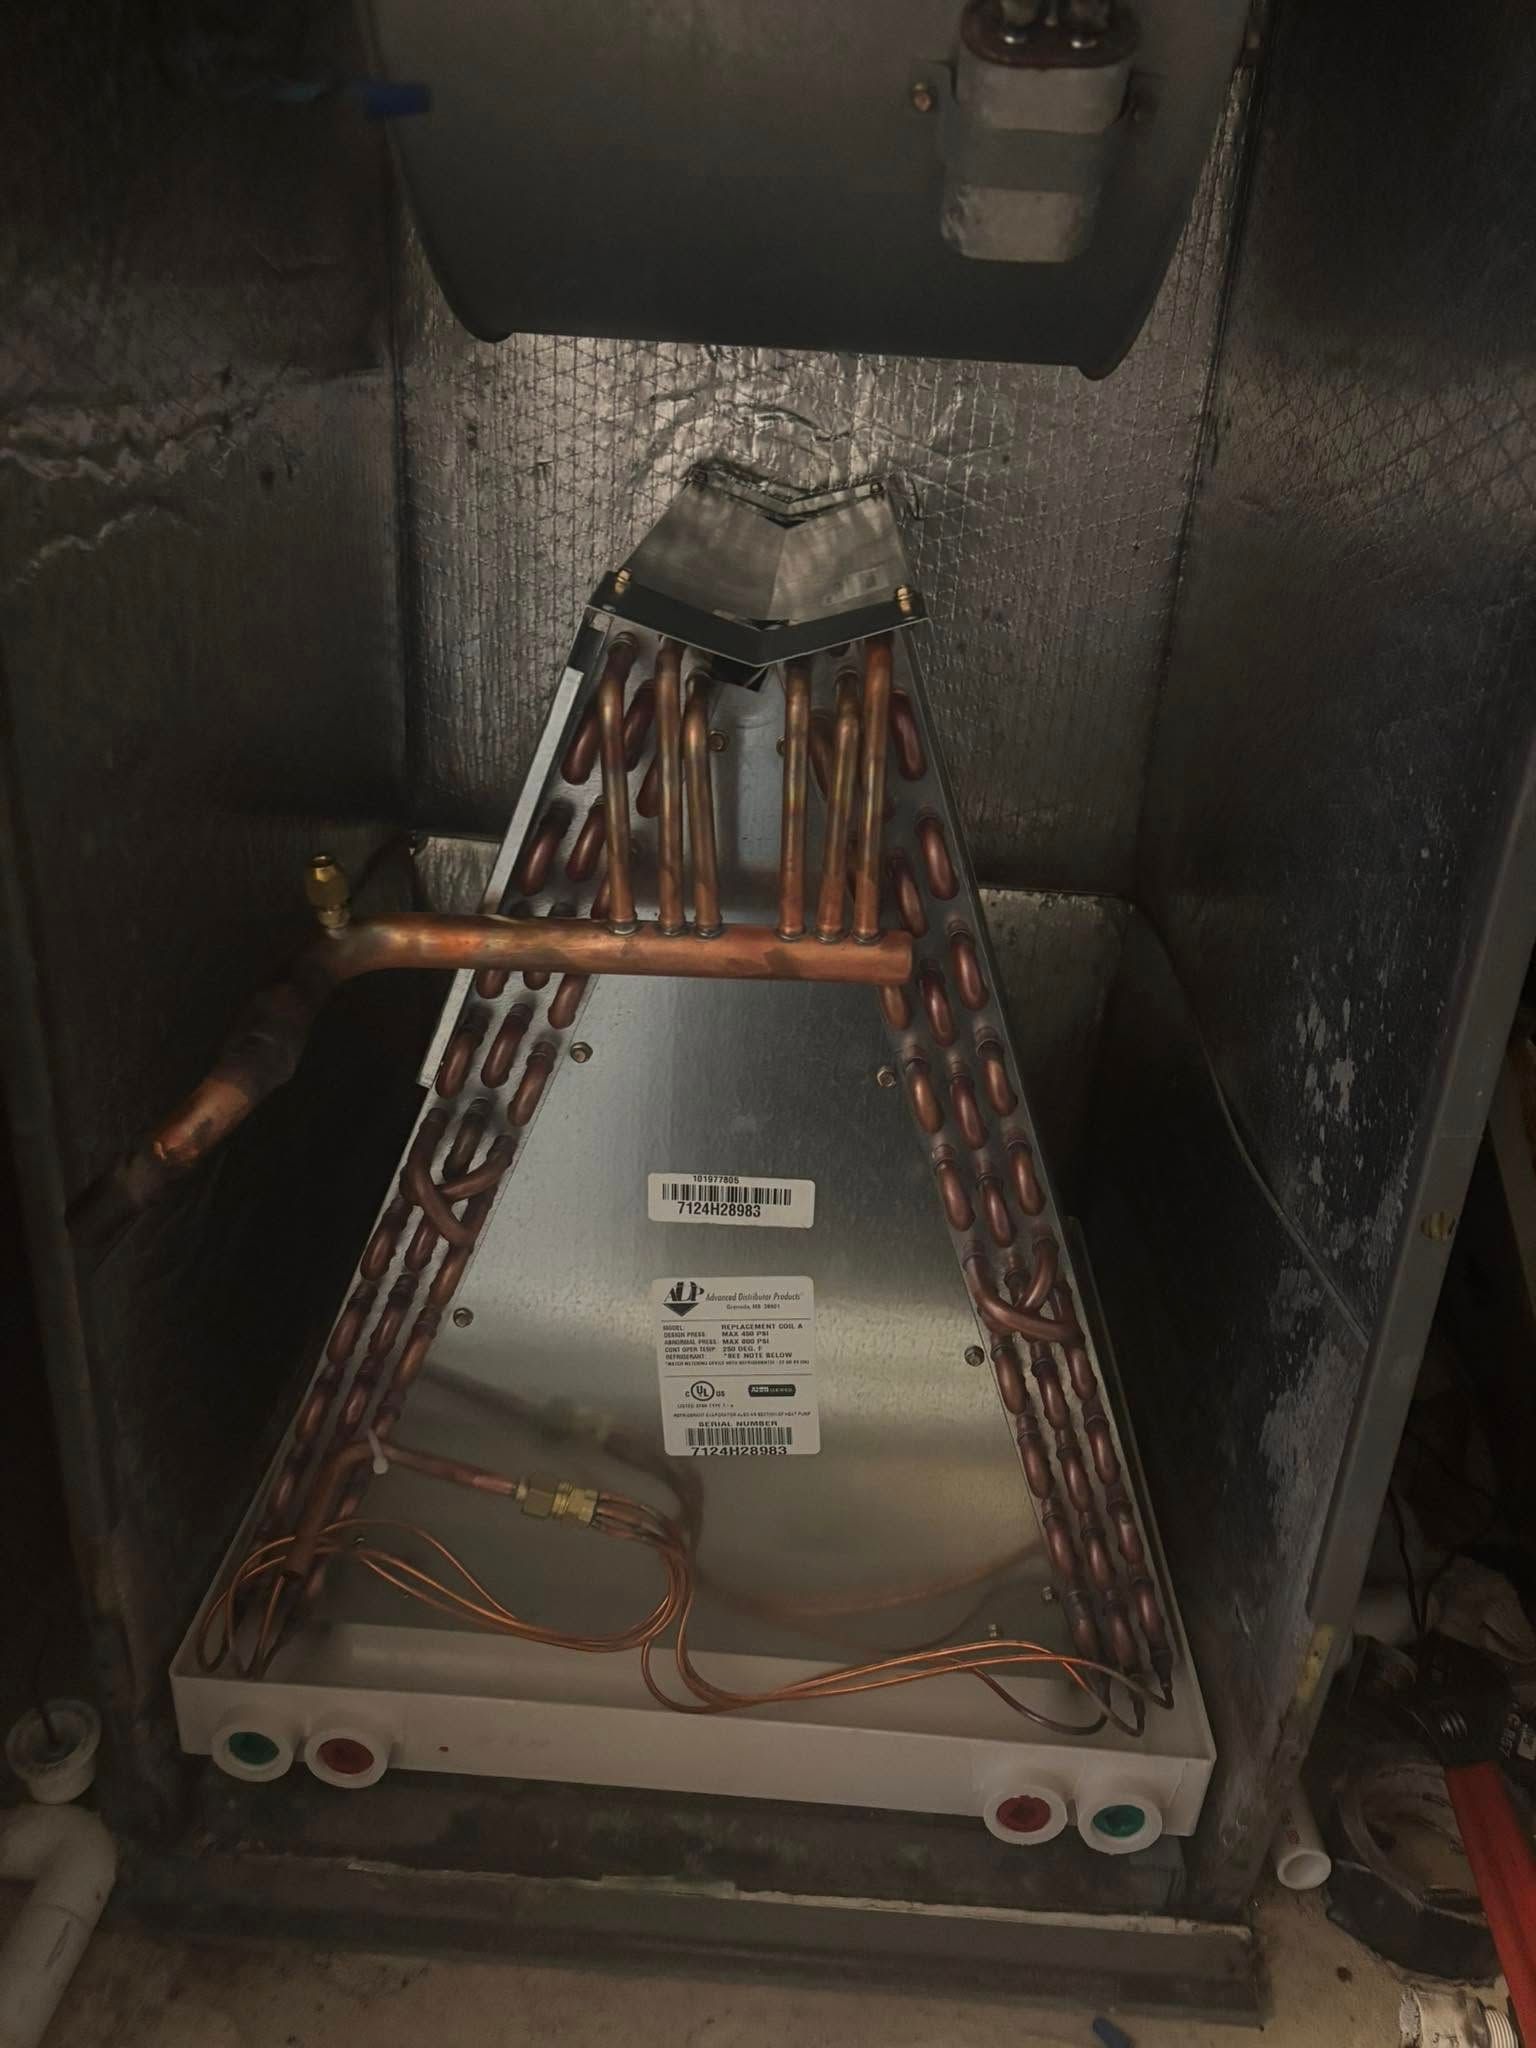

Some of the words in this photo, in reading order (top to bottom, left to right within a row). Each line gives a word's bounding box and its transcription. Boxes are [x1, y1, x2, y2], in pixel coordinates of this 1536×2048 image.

[693, 1175, 739, 1184] 101977805
[677, 1201, 761, 1218] 7124H28983
[705, 1292, 737, 1302] Advanced
[773, 1291, 801, 1301] Products
[690, 1445, 788, 1456] 7124H28983
